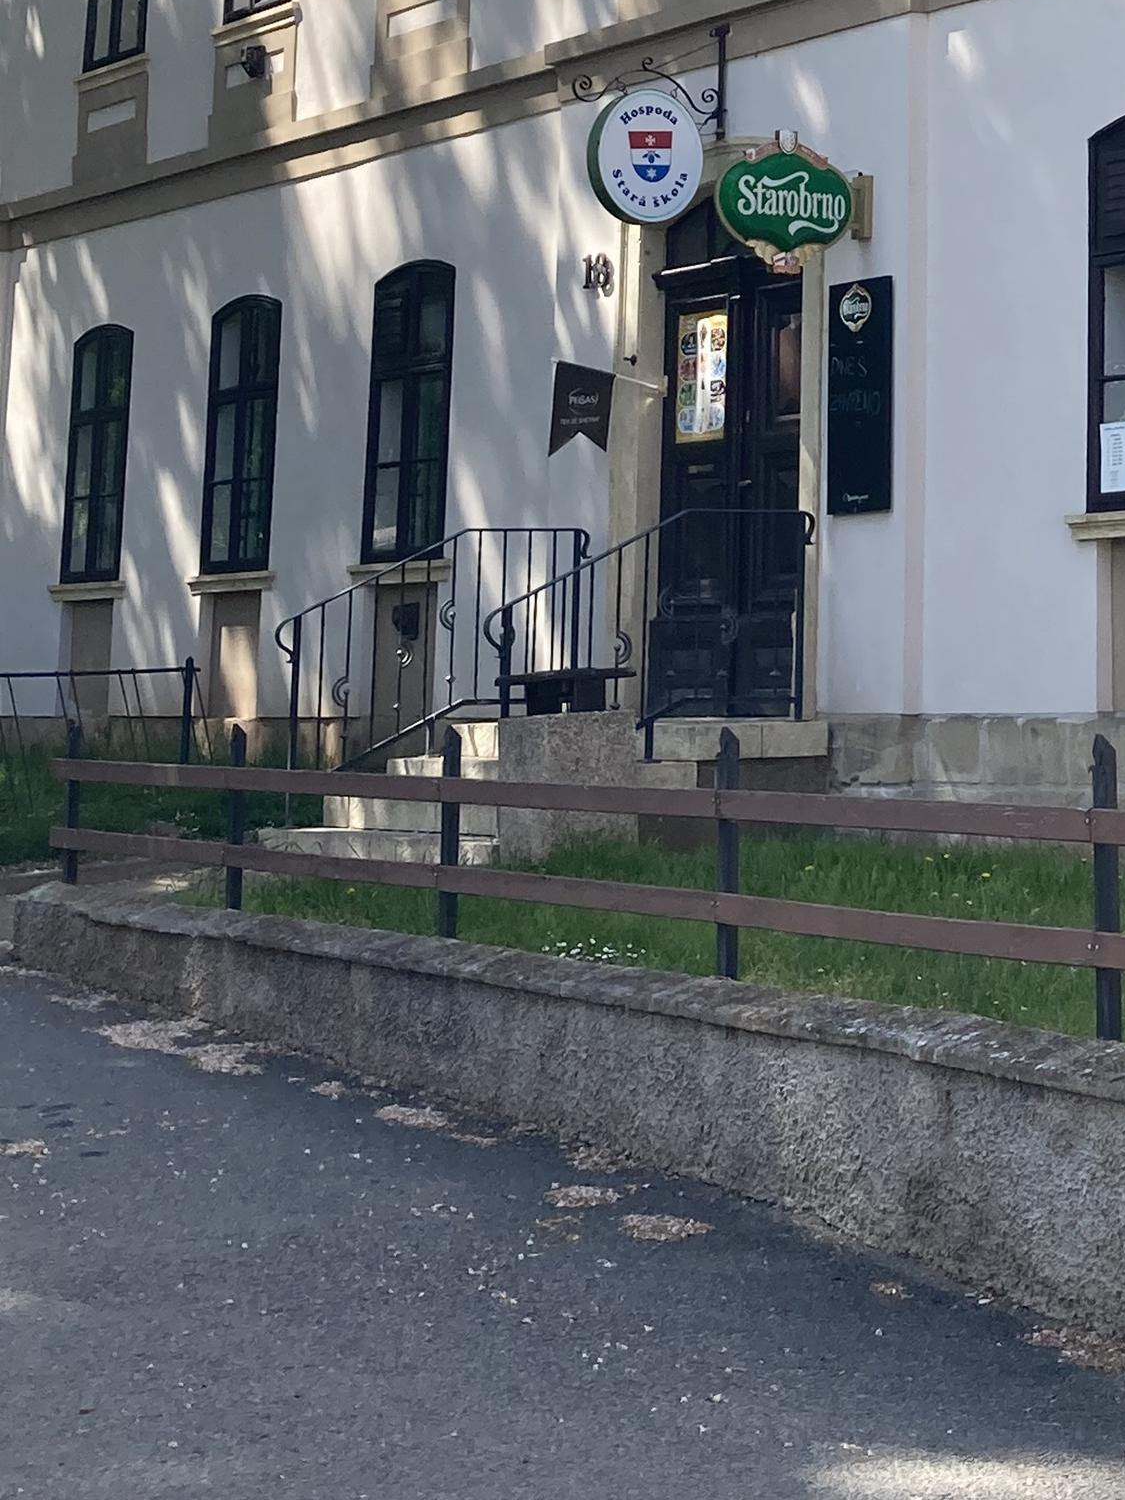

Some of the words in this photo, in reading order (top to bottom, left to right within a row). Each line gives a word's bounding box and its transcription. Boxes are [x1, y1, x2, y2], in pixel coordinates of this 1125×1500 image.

[620, 105, 678, 125] Hospoda
[612, 169, 646, 207] Stará
[653, 173, 688, 208] škola
[737, 171, 846, 236] Starobrno
